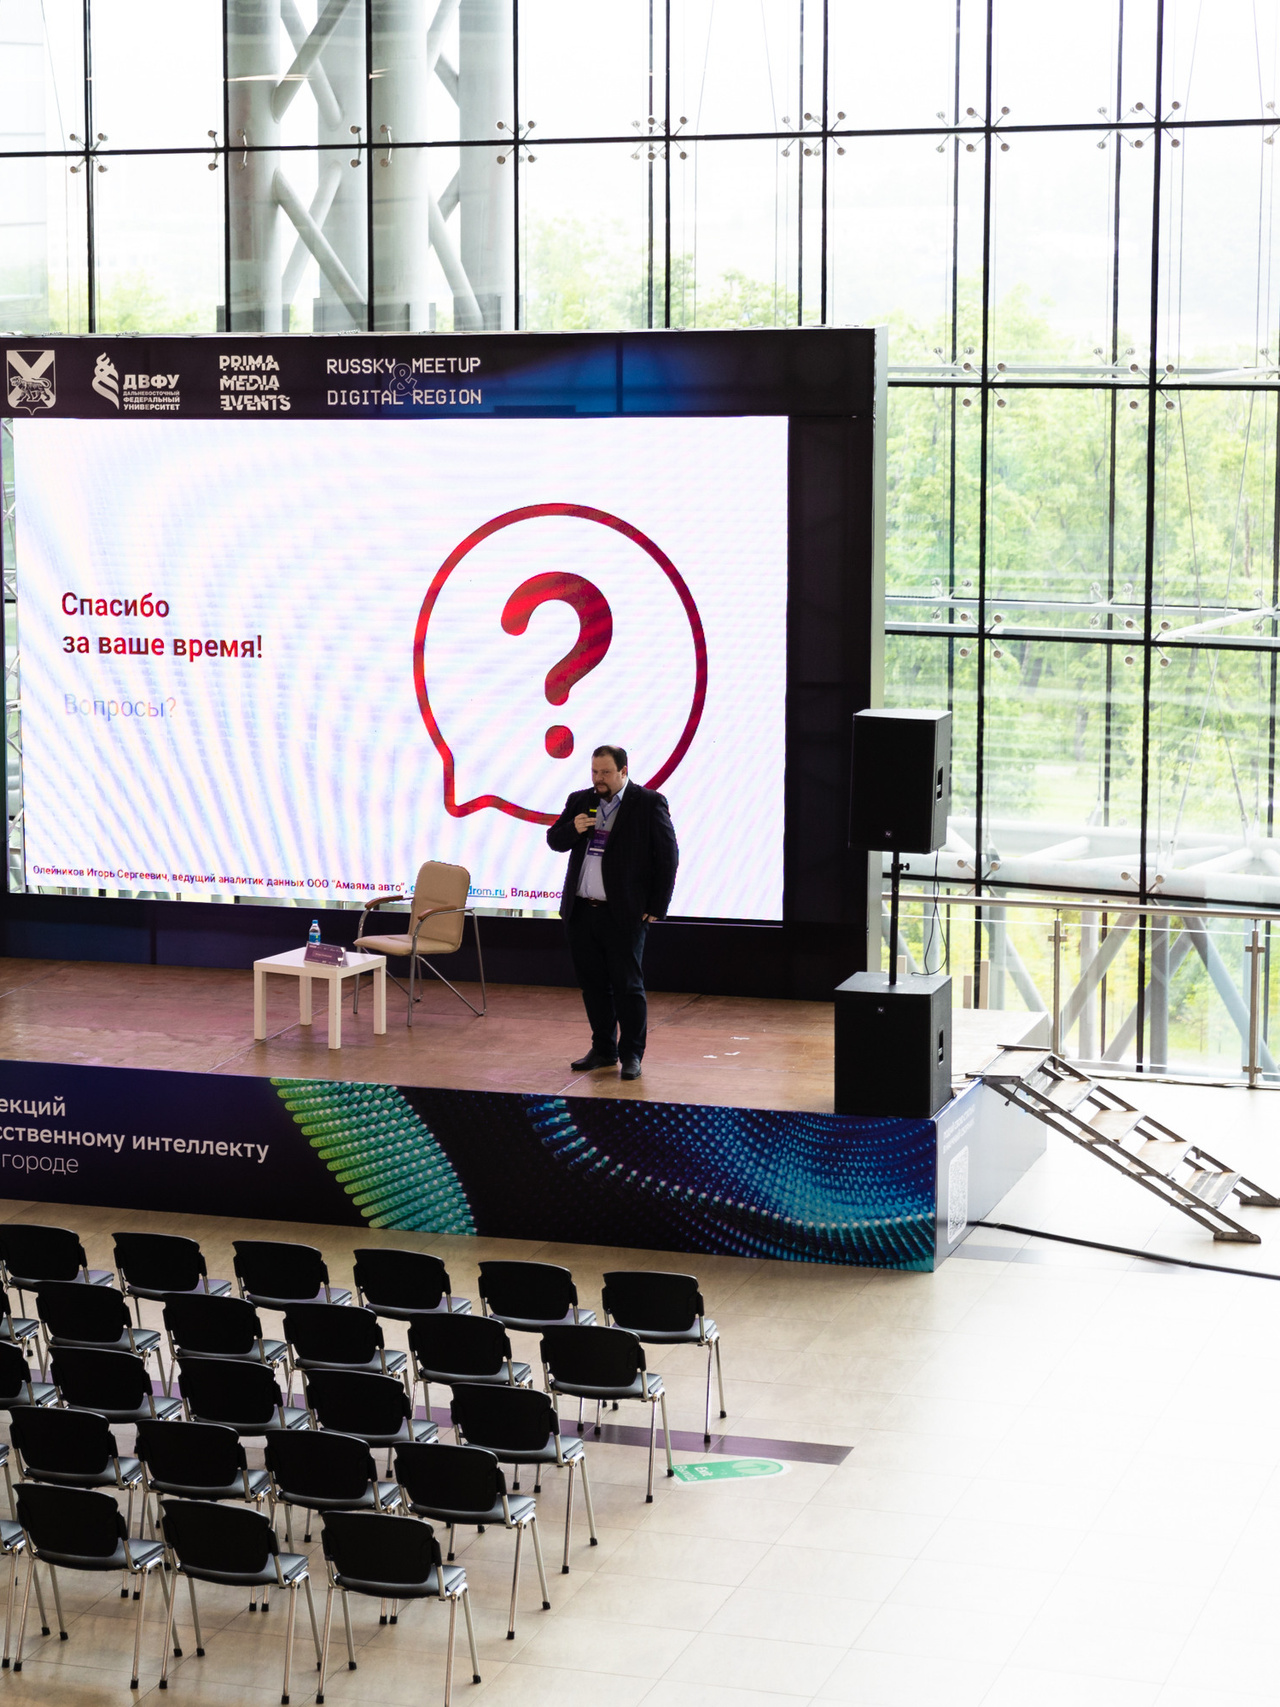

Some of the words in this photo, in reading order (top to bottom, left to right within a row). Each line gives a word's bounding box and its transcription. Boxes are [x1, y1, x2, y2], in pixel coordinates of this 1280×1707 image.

[219, 355, 280, 371] PRIMA
[327, 359, 395, 374] RUSSKY
[412, 358, 481, 373] MEETUP
[123, 374, 179, 390] ДВФУ
[220, 375, 280, 391] MEDIA
[220, 395, 291, 411] EVENTS
[328, 390, 404, 405] DIGITAL
[413, 389, 482, 405] REGION
[62, 592, 170, 618] Спасибо
[62, 636, 90, 654] за
[99, 637, 164, 655] ваше
[173, 635, 262, 662] время!
[65, 694, 177, 722] Вопросы?
[33, 865, 84, 877] Олейников
[86, 868, 115, 879] Игорь
[117, 870, 170, 882] Сергеевич,
[172, 873, 215, 884] ведущий
[219, 875, 264, 885] аналитик
[266, 878, 304, 887] данных
[307, 878, 329, 888] ООО
[332, 880, 375, 890] "Амаяма
[511, 888, 563, 899] Владивос
[133, 1136, 269, 1163] интеллекту
[2, 1154, 78, 1175] городе
